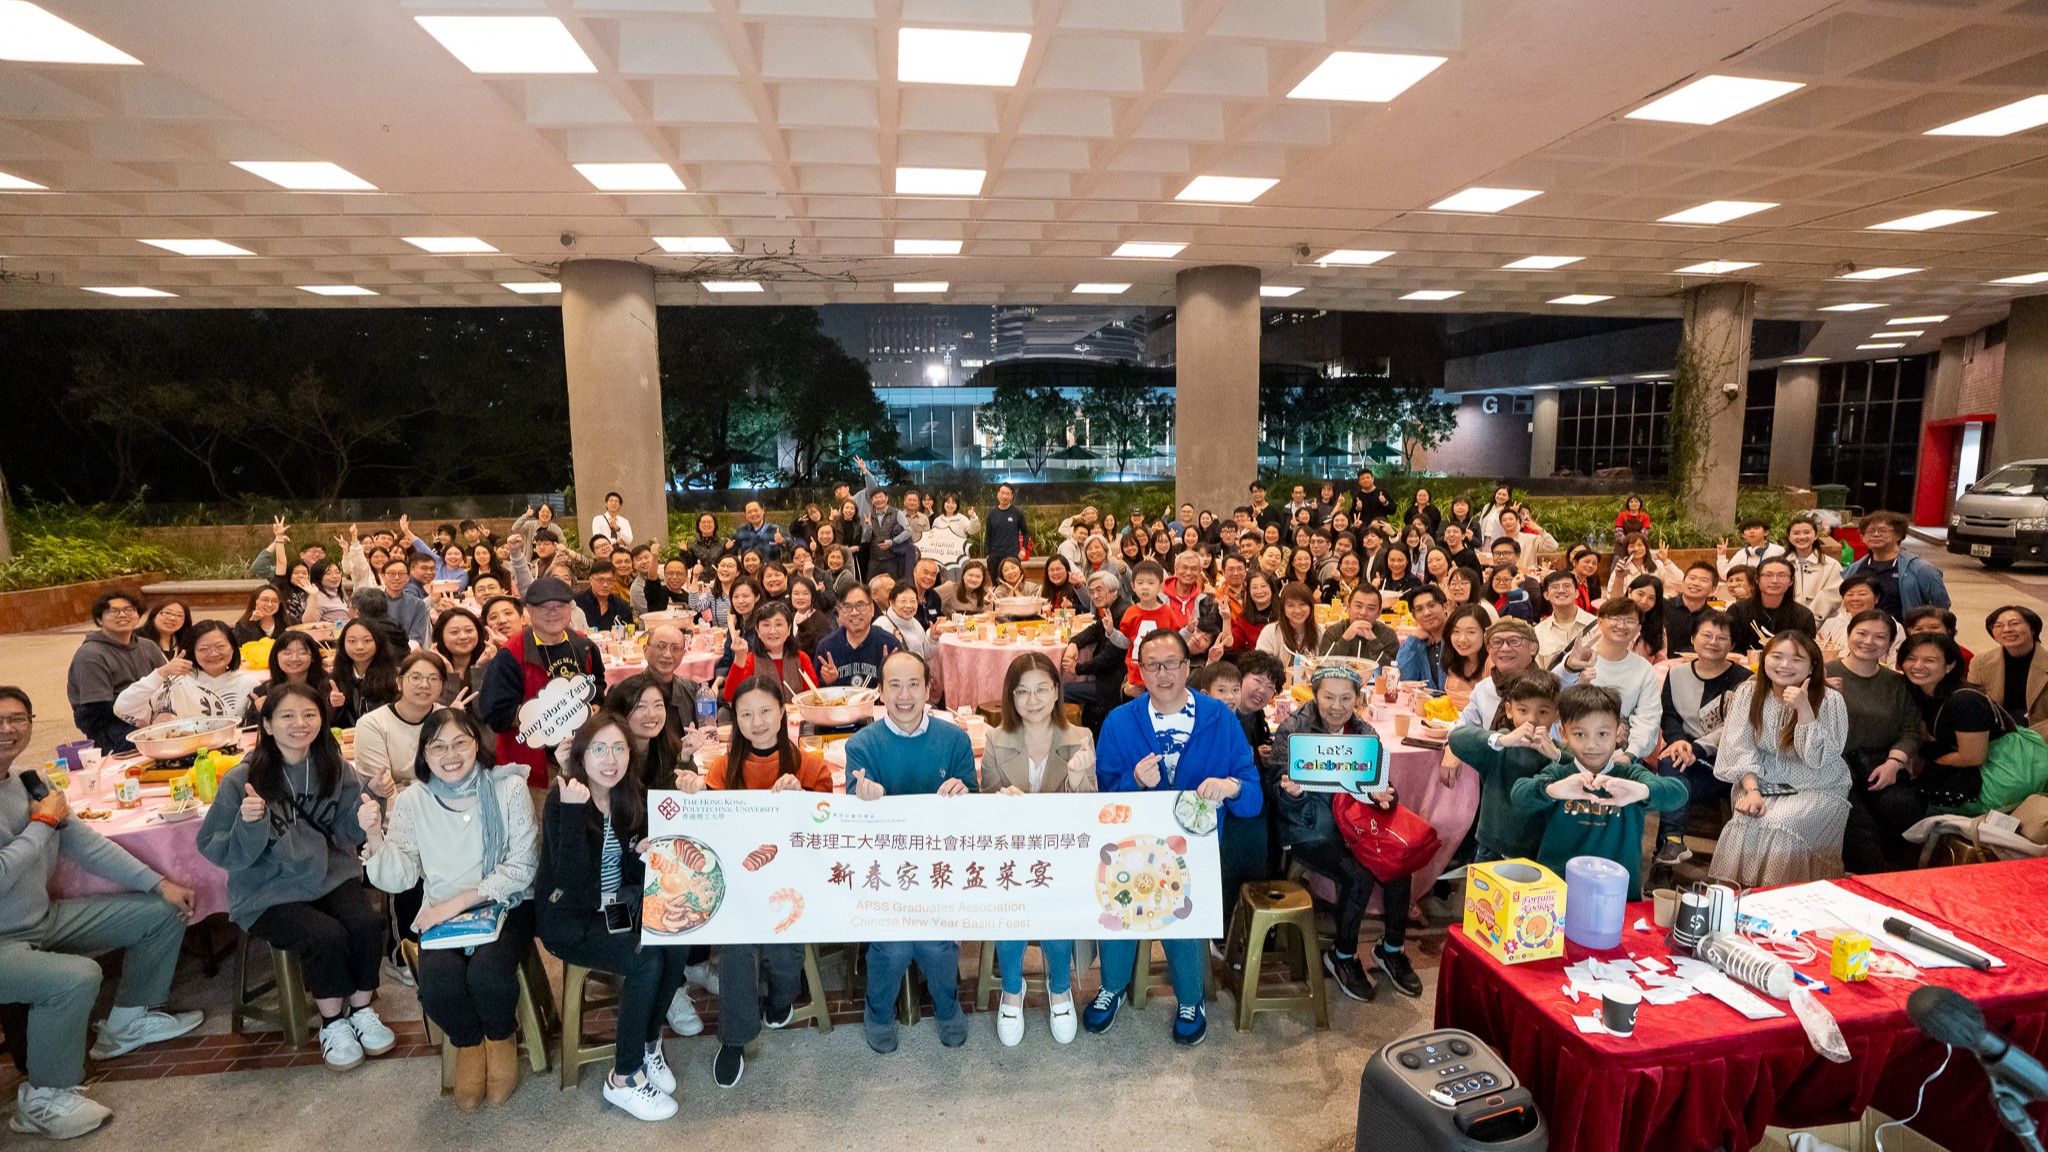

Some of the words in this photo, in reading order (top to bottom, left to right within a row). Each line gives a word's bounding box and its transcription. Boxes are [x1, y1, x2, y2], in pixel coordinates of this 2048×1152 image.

[1482, 395, 1498, 415] G
[515, 720, 543, 744] Many
[543, 697, 568, 721] More
[566, 674, 596, 699] Years
[543, 725, 555, 737] to
[555, 698, 588, 726] Come!
[1316, 744, 1353, 756] Let's
[1294, 759, 1373, 771] Celebrate!
[789, 831, 1091, 851] 香港理工大學應用社會科學系畢業同學會
[827, 859, 1054, 892] 新春家聚盆菜宴
[856, 900, 889, 912] APSS
[893, 901, 955, 913] Graduates
[957, 901, 1026, 913] Association
[851, 915, 899, 928] Chinese
[902, 917, 928, 927] New
[932, 917, 958, 928] Year
[962, 918, 995, 928] Basin
[998, 918, 1031, 928] Feast
